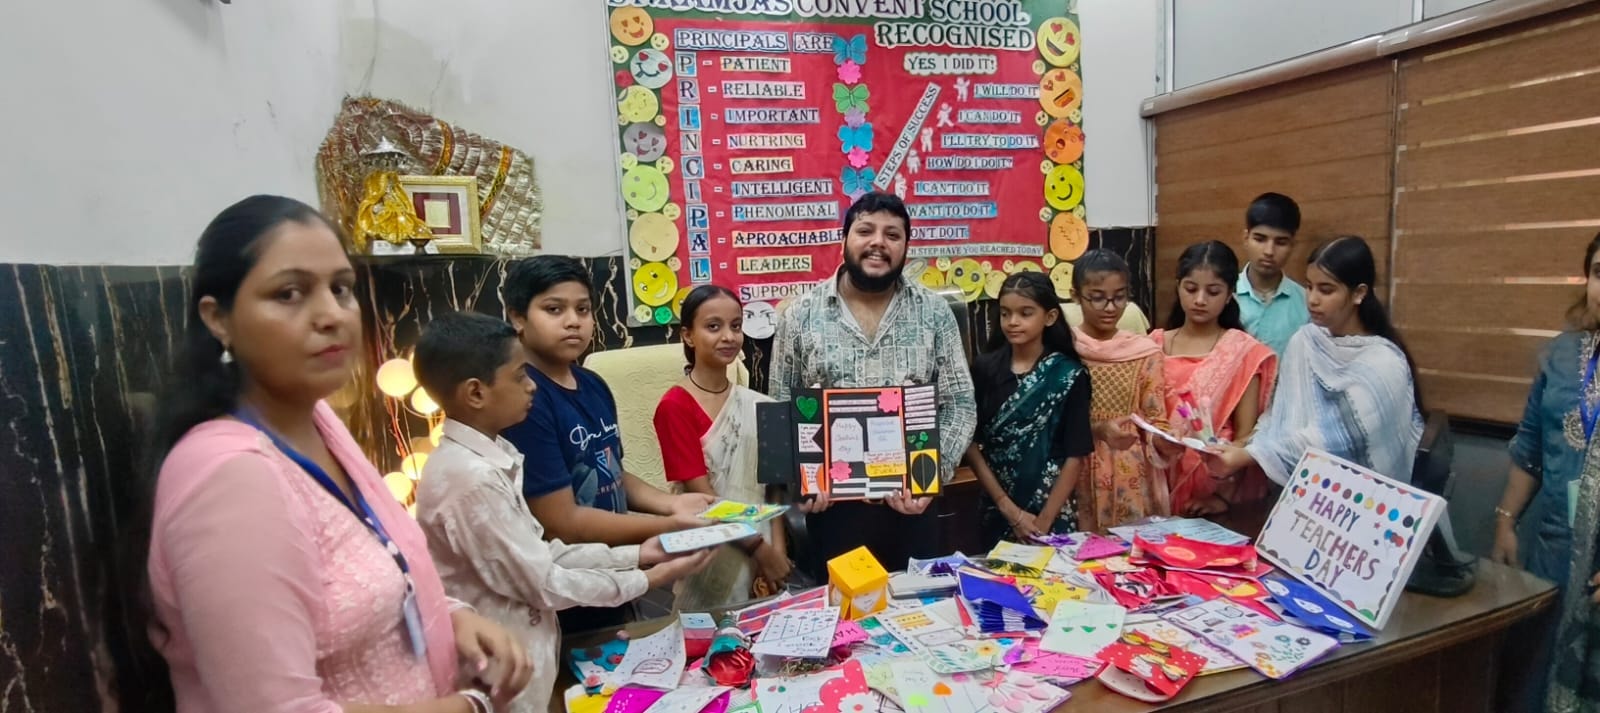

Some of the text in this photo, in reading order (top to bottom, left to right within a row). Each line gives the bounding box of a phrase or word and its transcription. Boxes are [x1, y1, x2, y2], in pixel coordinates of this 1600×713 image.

[931, 1, 1025, 23] SCHOOL
[678, 32, 833, 50] PRINCIPALS ARE
[877, 25, 1032, 49] RECOGNISED
[723, 57, 789, 72] PATIENT
[908, 58, 936, 70] YES
[943, 58, 948, 70] I
[953, 58, 975, 70] DID
[724, 83, 803, 97] RELIABLE
[982, 85, 1008, 96] WILL
[1011, 86, 1025, 96] DO
[1028, 86, 1038, 96] IT
[728, 109, 818, 122] IMPORTANT
[966, 111, 989, 121] CAN
[992, 111, 1007, 121] DO
[1010, 112, 1019, 122] IT
[729, 134, 804, 148] NURTRING
[878, 86, 937, 186] STEPS OF SUCCESS
[943, 135, 1036, 146] I'LL TRY TO DO IT
[732, 158, 791, 172] CARING
[927, 158, 953, 168] HOW
[956, 158, 971, 168] DO
[981, 158, 995, 168] DO
[735, 180, 831, 195] INTELLIGENT
[923, 182, 956, 193] CAN'T
[959, 183, 974, 193] DO
[977, 182, 987, 193] IT
[734, 203, 836, 218] PHENOMENAL
[907, 205, 990, 217] WANT TO DO IT
[910, 227, 966, 238] ON'T DO IT
[919, 248, 938, 256] STEP
[940, 247, 961, 256] HAVE
[980, 246, 1016, 254] REACHED
[1017, 246, 1042, 254] TODAY
[741, 257, 811, 272] LEADERS
[1308, 492, 1361, 532] HAPPY
[1289, 509, 1380, 581] TEACHERS
[1304, 548, 1345, 588] DAY
